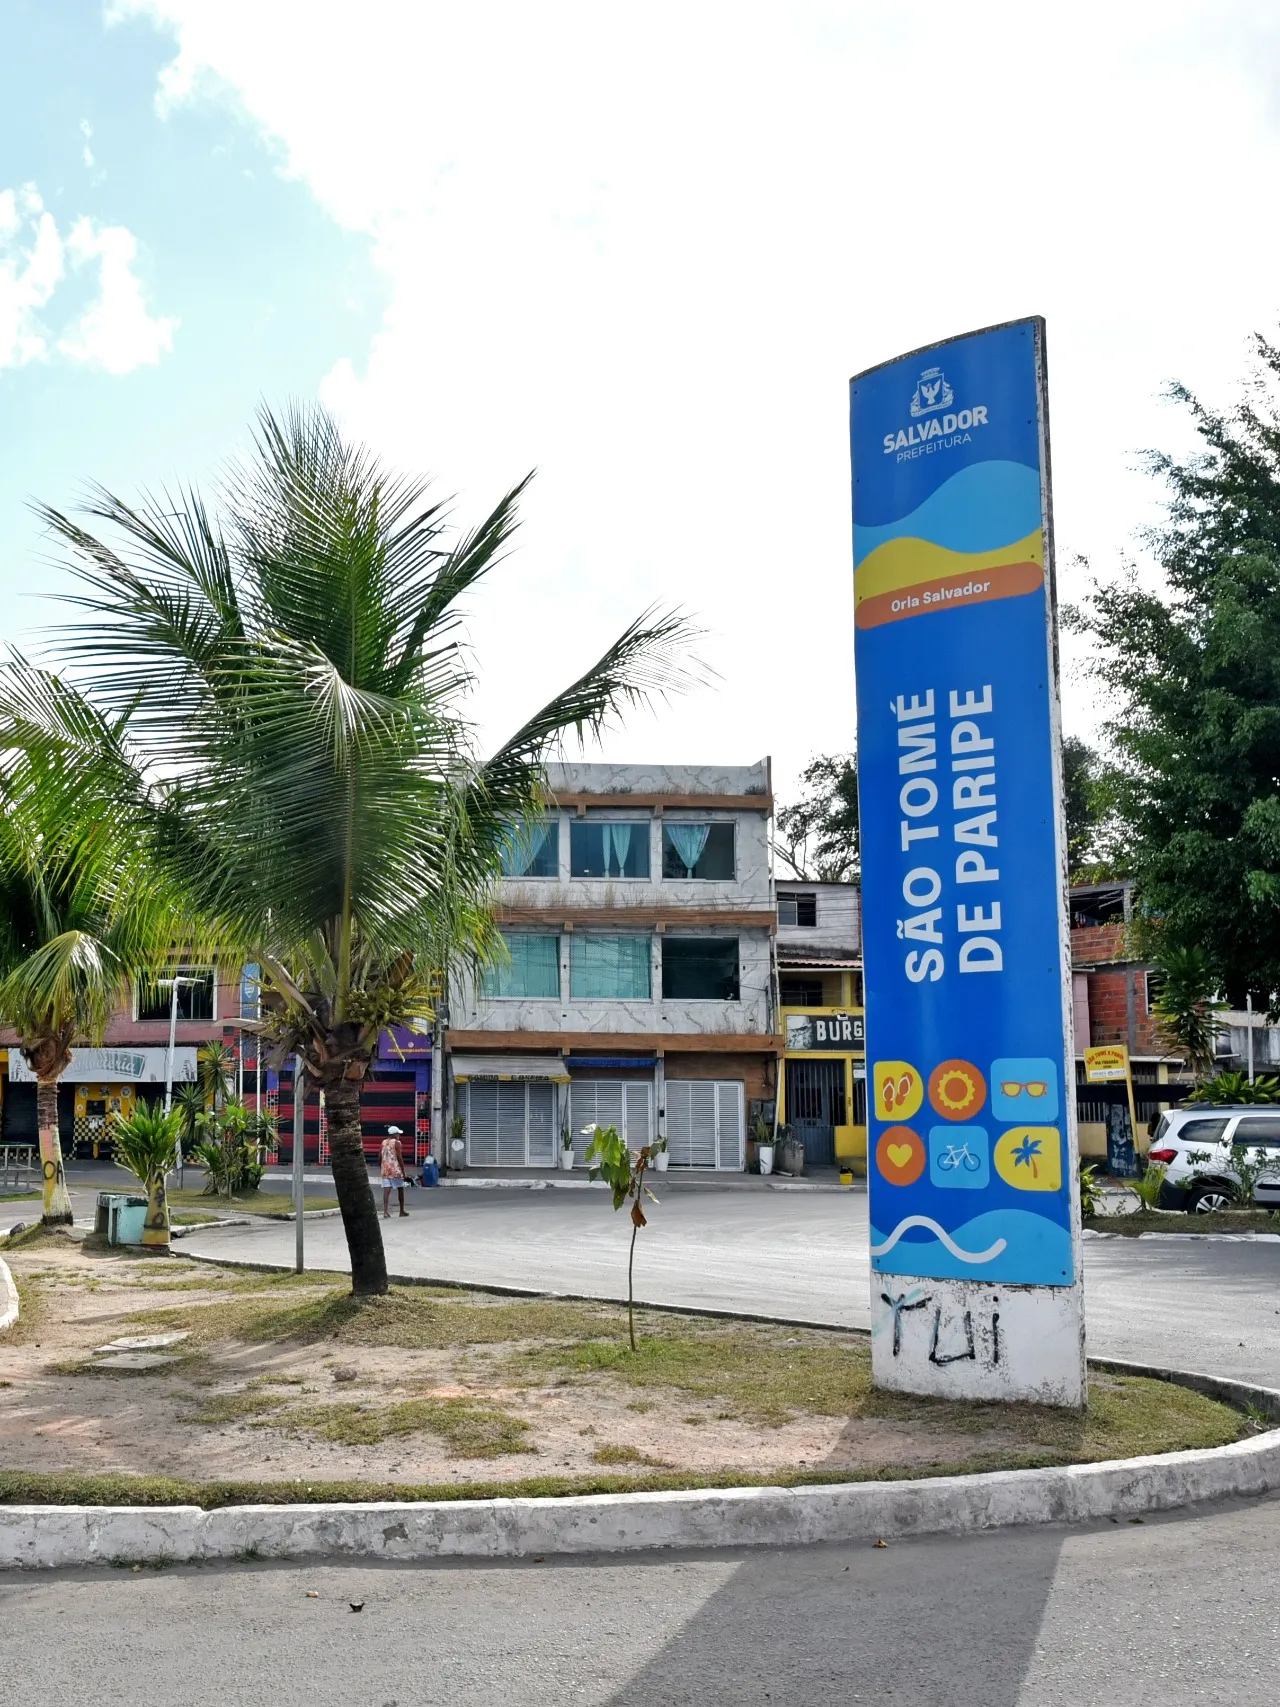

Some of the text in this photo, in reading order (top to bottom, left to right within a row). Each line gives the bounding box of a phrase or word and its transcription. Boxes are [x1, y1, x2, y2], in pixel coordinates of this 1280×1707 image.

[883, 405, 988, 454] SALVADOR
[896, 433, 972, 464] PREFEITURA
[891, 582, 991, 612] Orla Salvador
[890, 688, 945, 983] SÃO TOMÉ
[949, 684, 1003, 974] DE PARIPE
[816, 1020, 863, 1041] BURG
